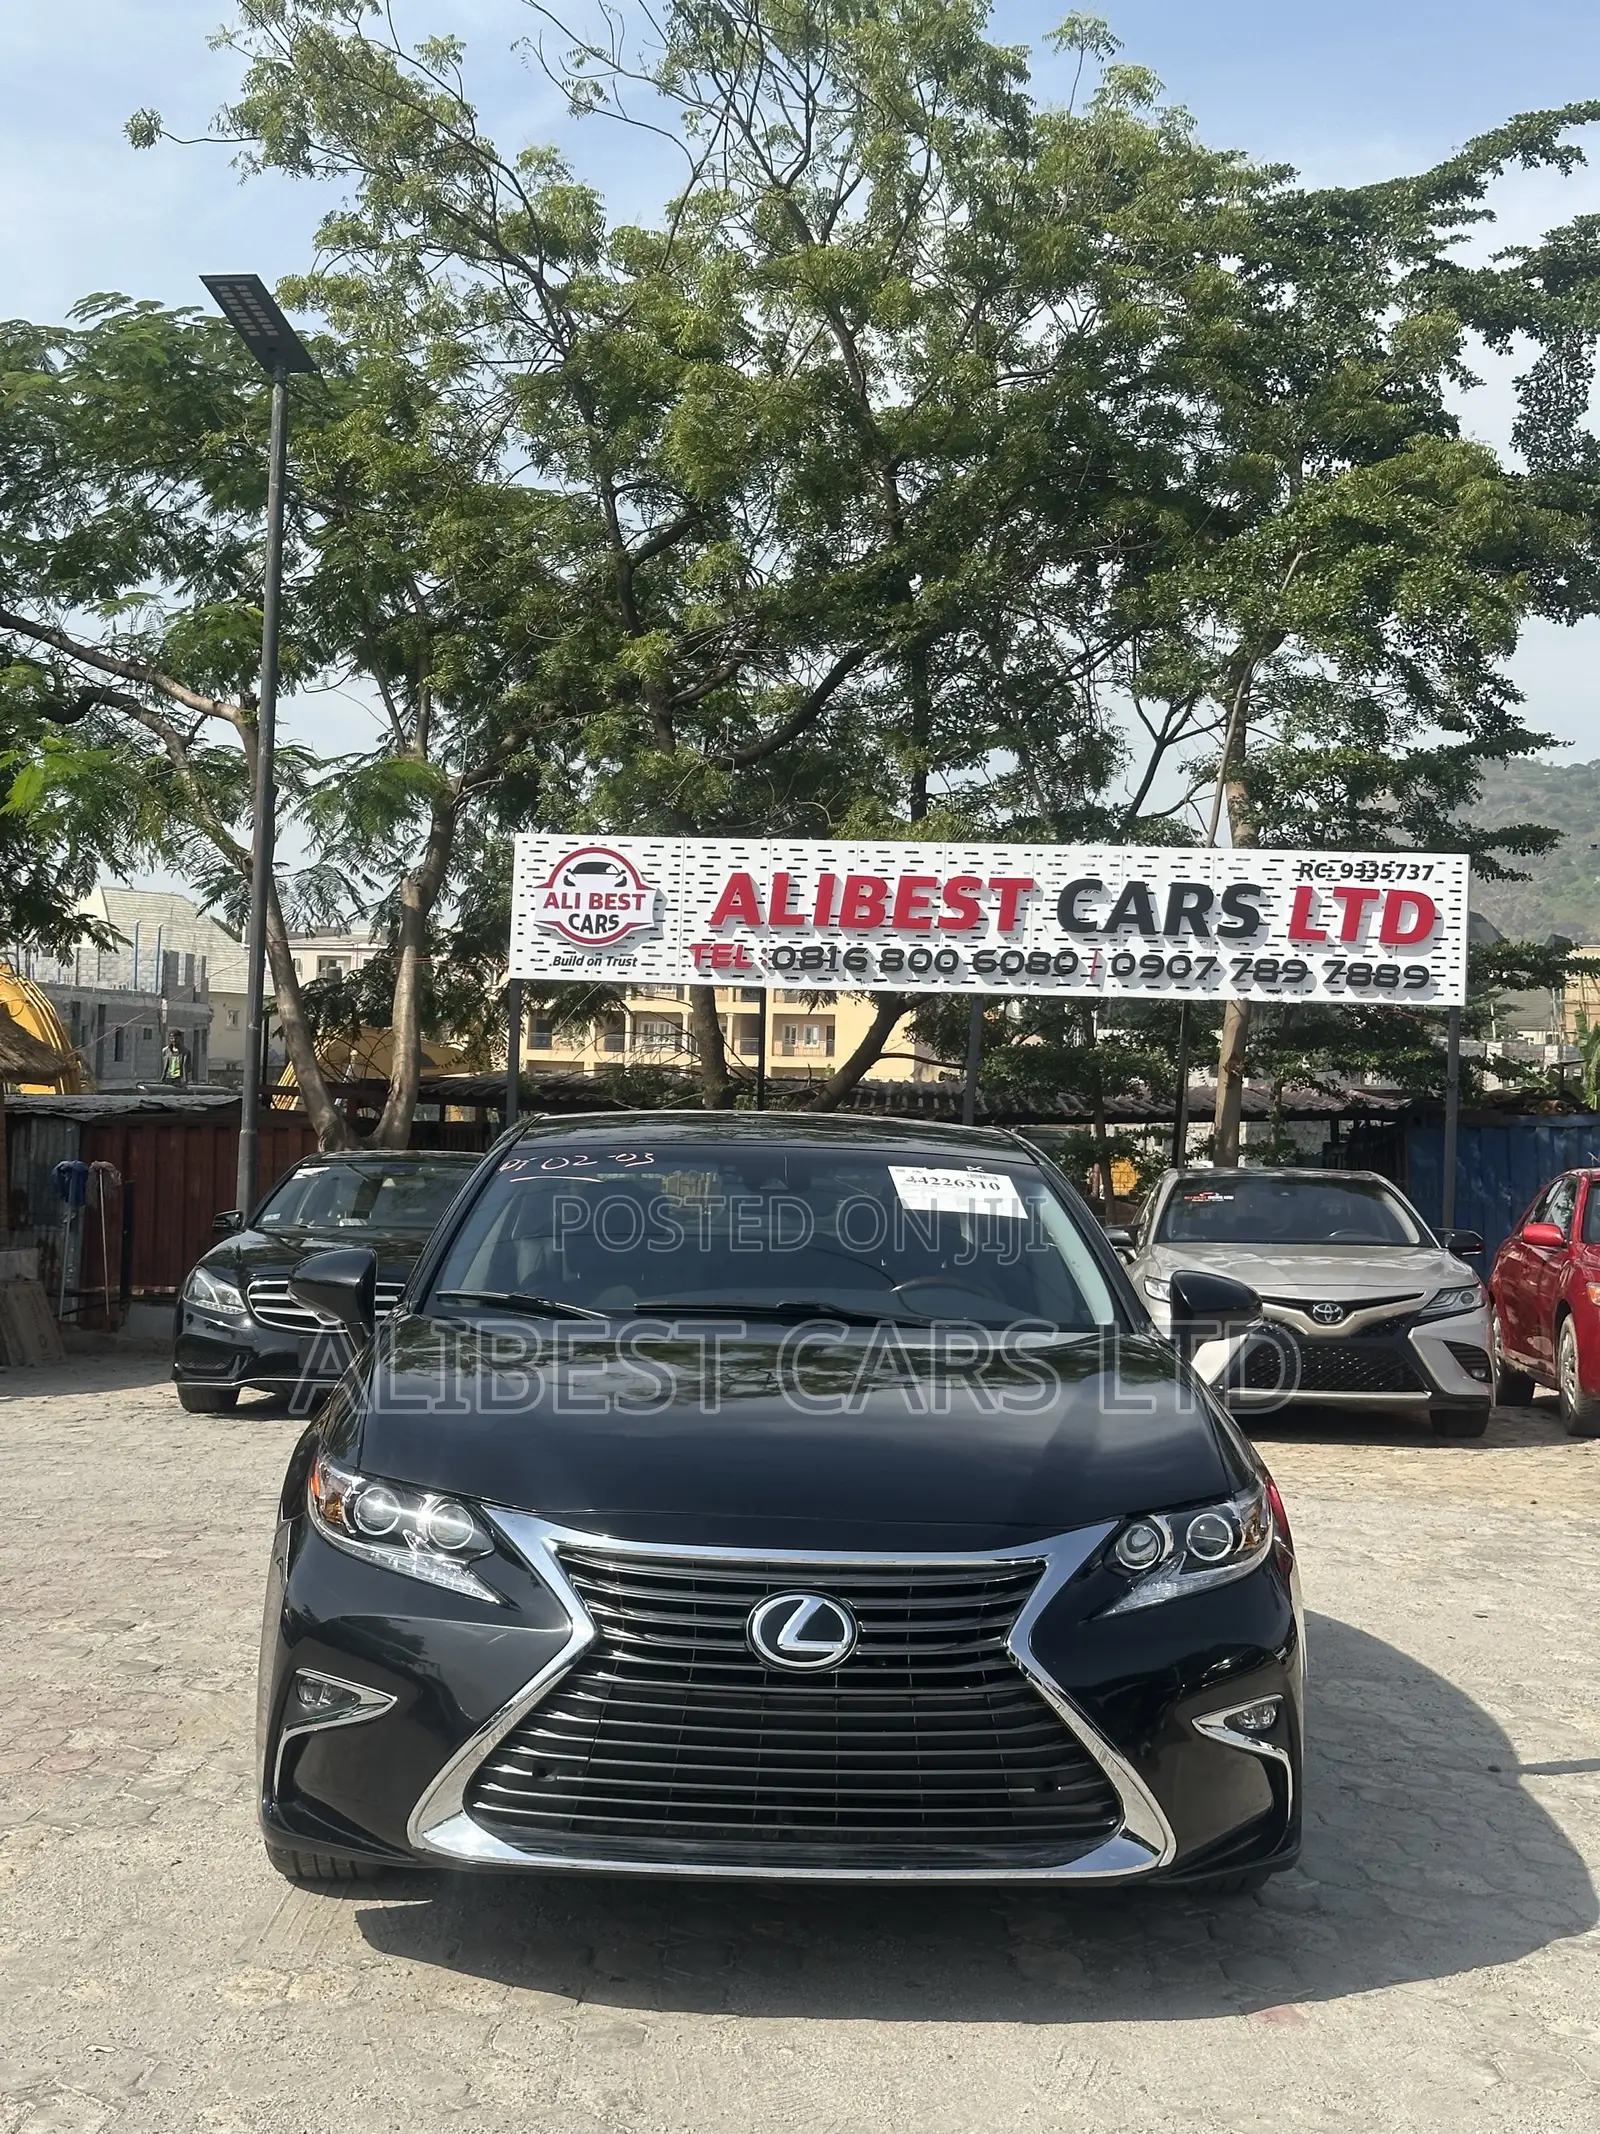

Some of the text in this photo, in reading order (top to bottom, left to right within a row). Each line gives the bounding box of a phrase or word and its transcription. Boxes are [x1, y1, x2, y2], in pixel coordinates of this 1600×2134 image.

[1340, 863, 1434, 881] 9335737
[543, 892, 646, 911] ALI BEST
[709, 872, 1436, 945] ALIBEST CARS LTD
[568, 913, 620, 935] CARS
[553, 955, 638, 967] Build on Trust
[771, 946, 867, 971] 0816
[879, 949, 959, 973] 800
[972, 949, 1078, 975] 6080
[1111, 953, 1217, 980] 0907
[1231, 958, 1308, 983] 789
[1323, 960, 1430, 989] 7889
